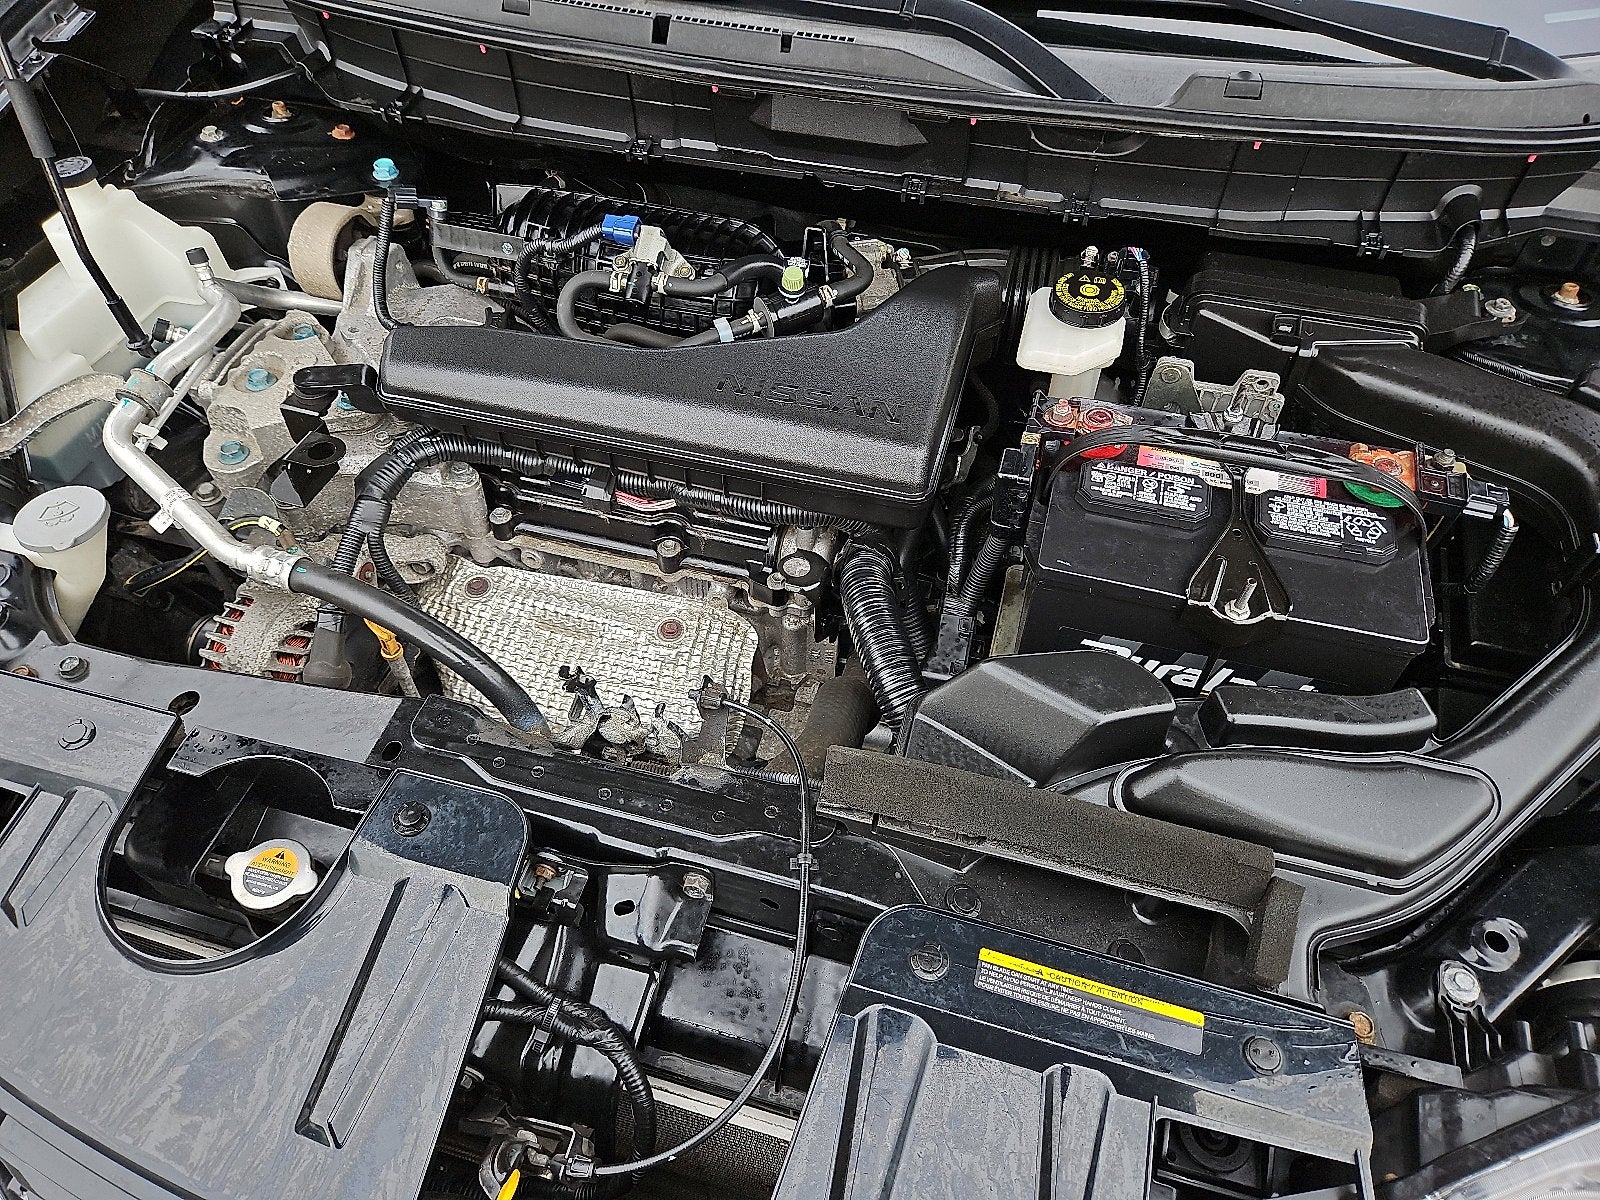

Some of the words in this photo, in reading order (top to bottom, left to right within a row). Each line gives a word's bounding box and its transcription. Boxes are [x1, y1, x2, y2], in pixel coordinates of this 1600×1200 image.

[715, 373, 903, 424] NISSAN
[1107, 462, 1147, 476] DANGER
[1158, 471, 1195, 485] POISON
[262, 857, 291, 868] WARNING
[980, 967, 989, 975] TO
[988, 970, 1003, 979] HELP
[1003, 974, 1020, 984] AVOID
[1067, 994, 1082, 1003] KEEP
[1082, 999, 1102, 1009] HANDS
[1023, 974, 1040, 984] START
[1047, 981, 1060, 990] ANY
[977, 981, 994, 991] POUR
[1069, 1009, 1081, 1017] PAS
[1085, 1007, 1101, 1016] TOUT
